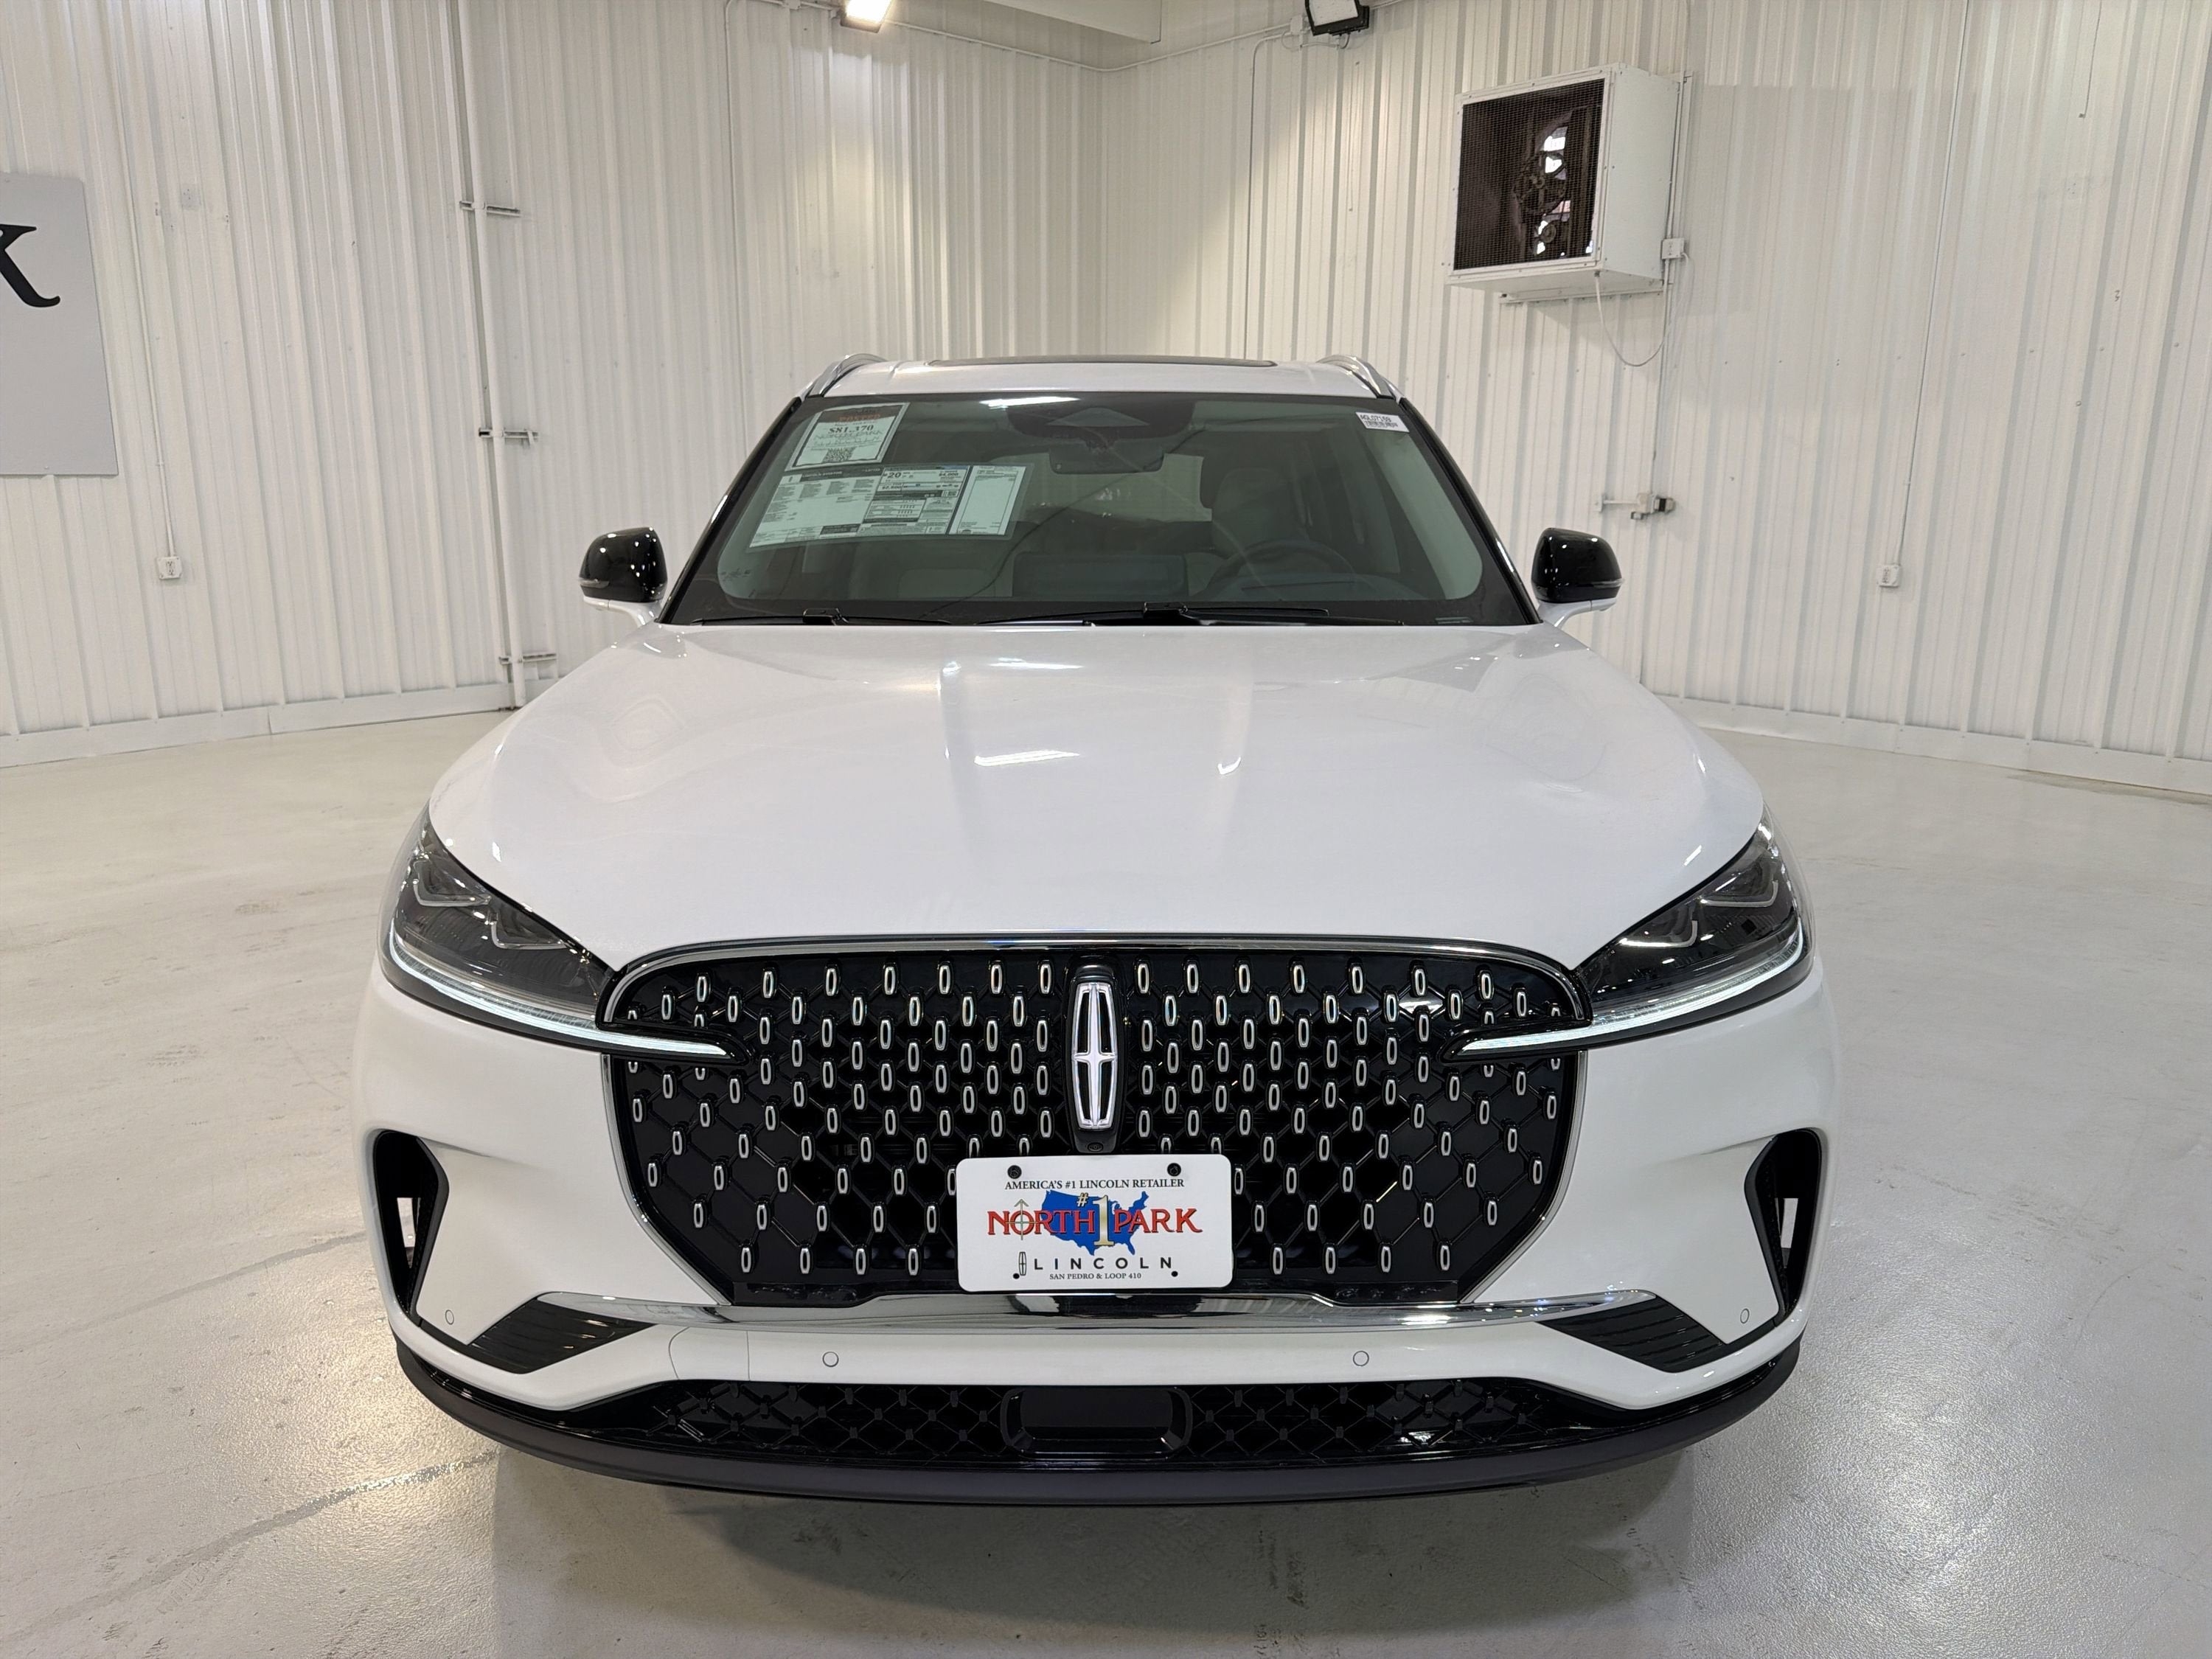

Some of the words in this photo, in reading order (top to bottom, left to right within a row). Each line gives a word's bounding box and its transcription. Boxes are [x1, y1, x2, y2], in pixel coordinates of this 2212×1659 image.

[1005, 1180, 1062, 1190] AMERICA'S
[1065, 1180, 1077, 1189] #1
[1079, 1180, 1130, 1189] LINCOLN
[1133, 1178, 1185, 1189] RETAILER
[987, 1208, 1096, 1236] NORTH
[1113, 1207, 1203, 1234] PARK
[1034, 1256, 1172, 1270] LINCOLN
